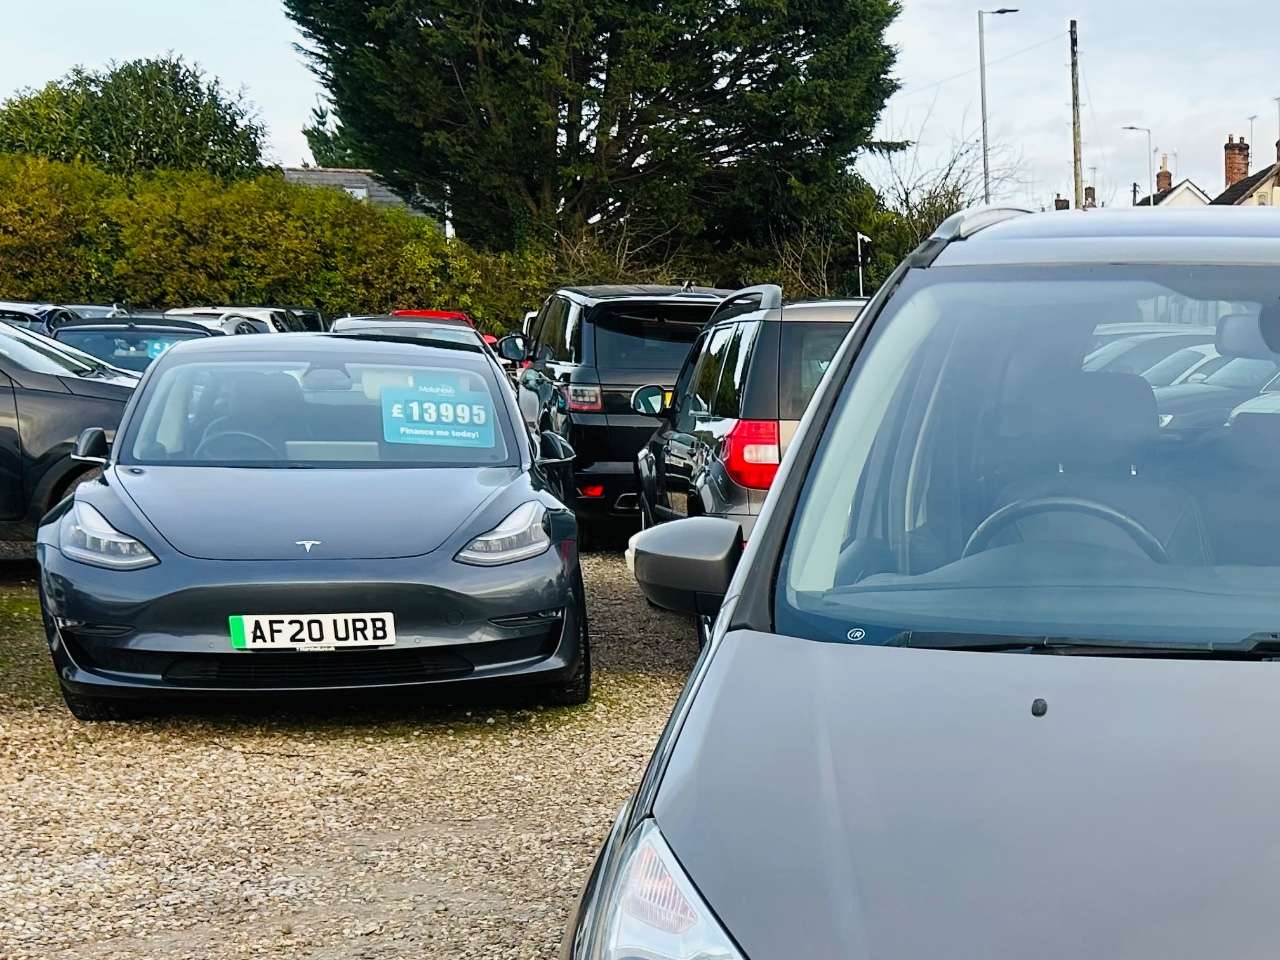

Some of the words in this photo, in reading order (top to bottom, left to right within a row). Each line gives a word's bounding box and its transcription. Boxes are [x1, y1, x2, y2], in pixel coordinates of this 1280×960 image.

[400, 426, 435, 437] Finance
[251, 618, 325, 643] AF20
[333, 617, 388, 642] URB
